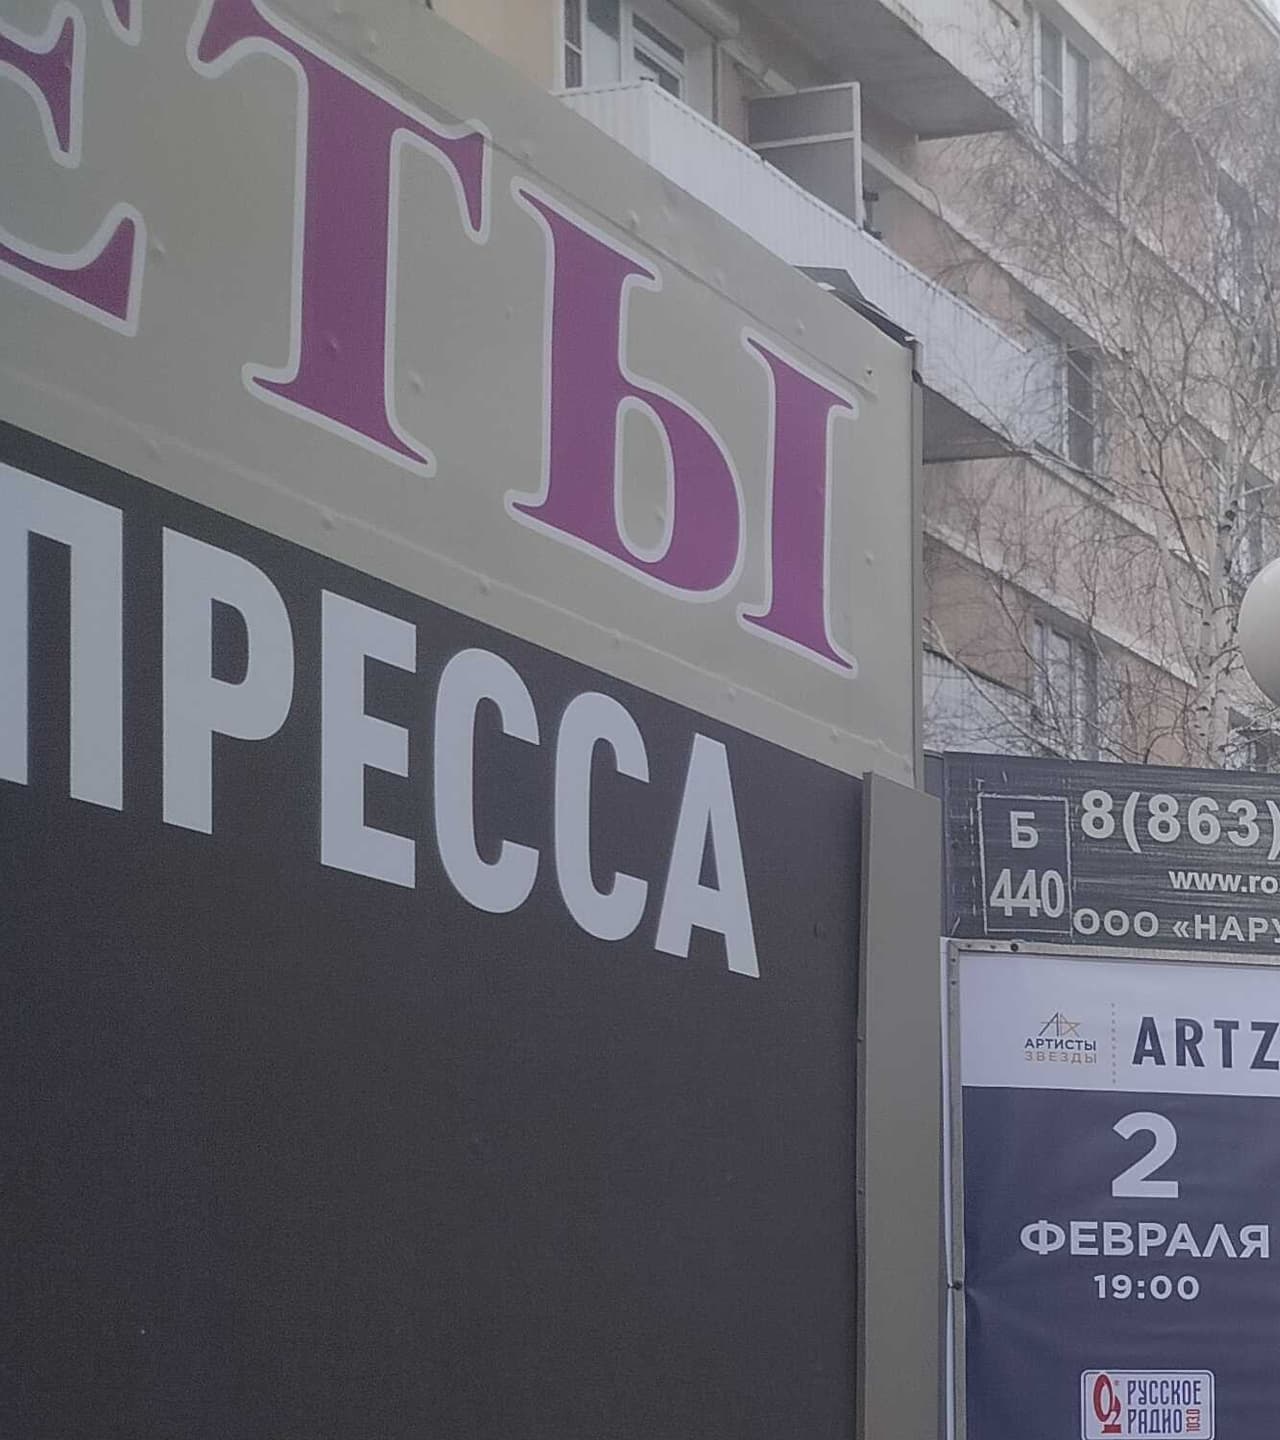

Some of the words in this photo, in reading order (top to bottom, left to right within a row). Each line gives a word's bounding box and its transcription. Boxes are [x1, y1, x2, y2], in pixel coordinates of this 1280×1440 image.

[0, 463, 760, 978] ПРЕССА
[1010, 811, 1039, 848] Б
[990, 868, 1065, 918] 440
[1073, 908, 1159, 937] ООО
[1024, 1038, 1096, 1051] АРТИСТЫ
[1024, 1051, 1097, 1064] ЗВЕЗДЫ
[1111, 1111, 1180, 1199] 2
[1019, 1219, 1271, 1260] ФЕВРАЛЯ
[1093, 1274, 1200, 1301] 19:00
[1127, 1380, 1201, 1405] РУССКОЕ
[1127, 1409, 1182, 1434] РАДИО
